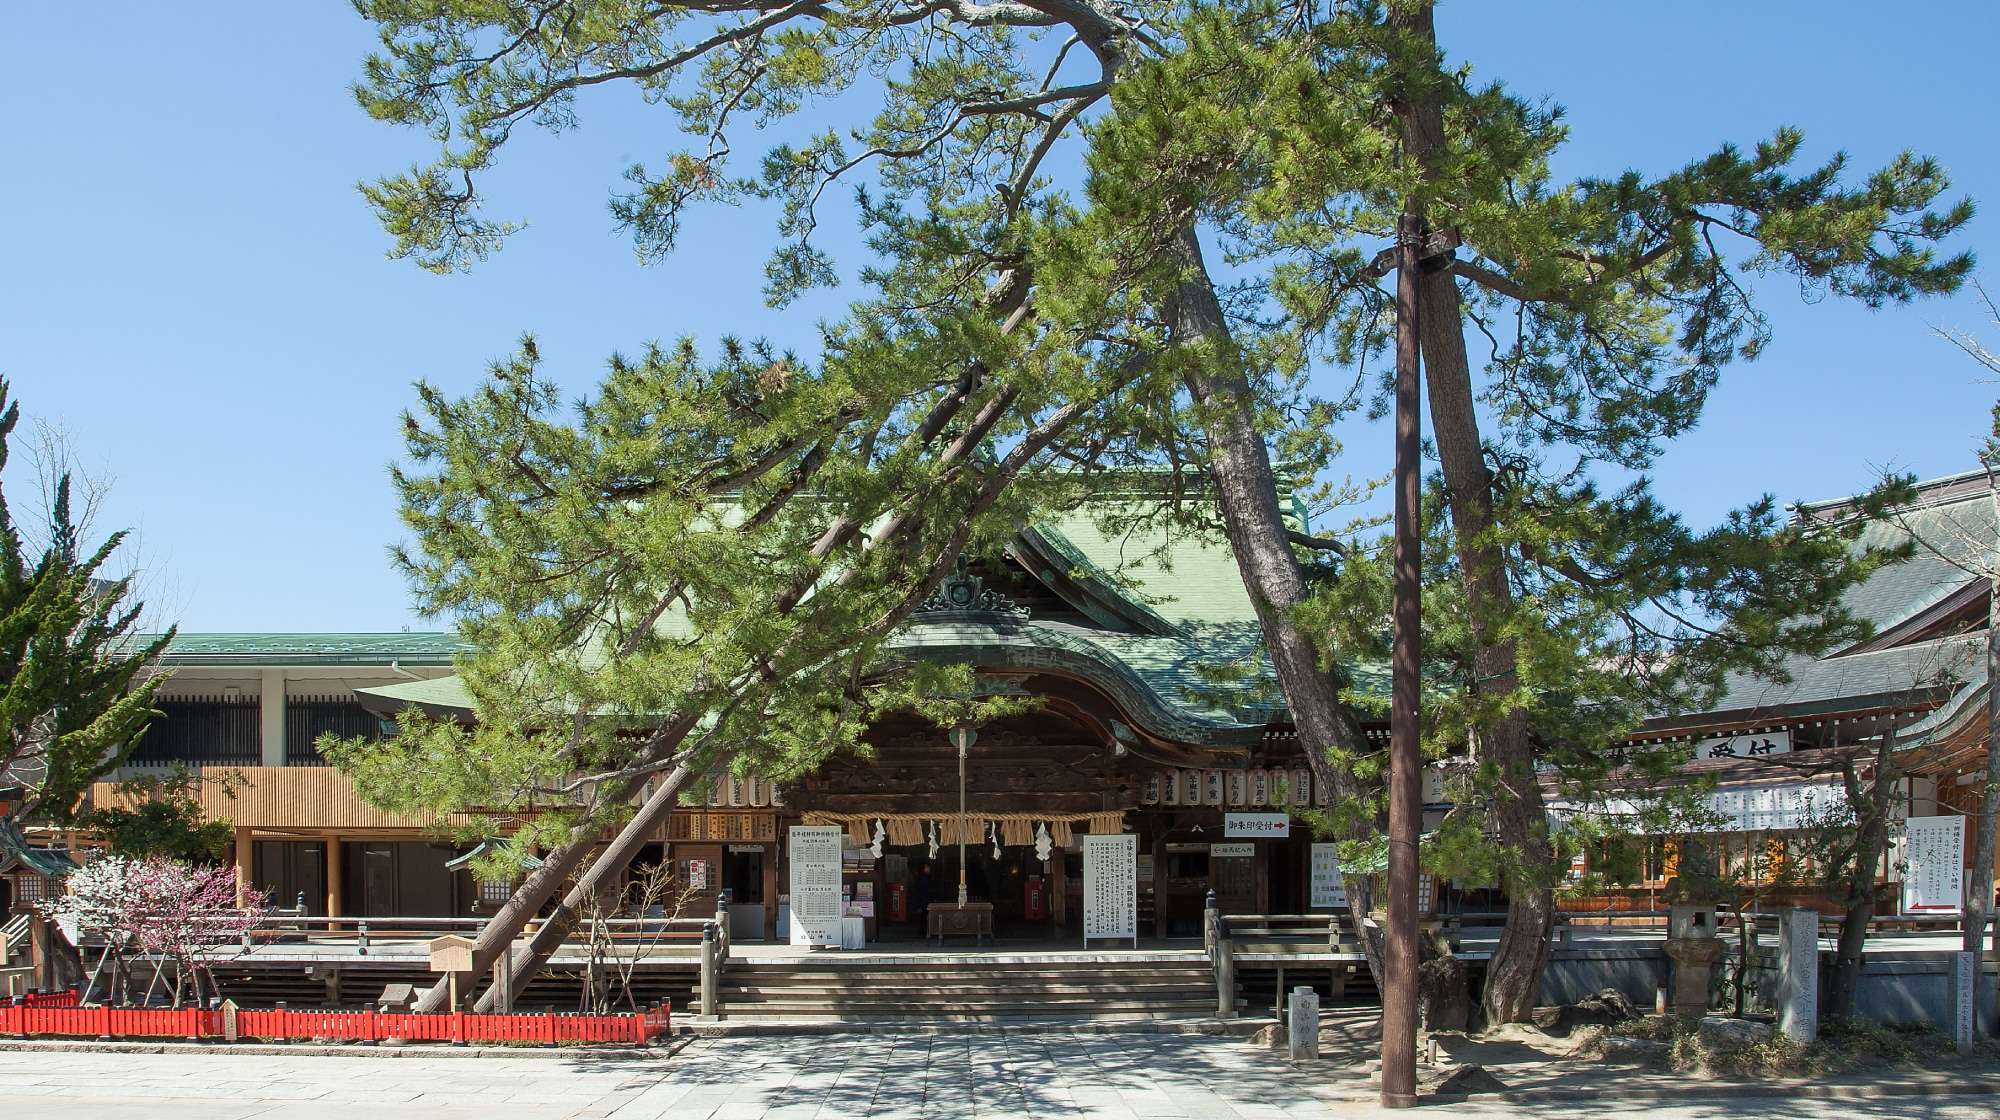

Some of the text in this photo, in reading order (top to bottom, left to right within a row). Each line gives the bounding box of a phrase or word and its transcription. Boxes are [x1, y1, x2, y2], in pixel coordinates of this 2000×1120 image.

[1228, 820, 1273, 831] 御朱印受付
[1950, 819, 1961, 890] ご祈祷受付・おはらい時間
[1299, 1000, 1311, 1048] 白山神社
